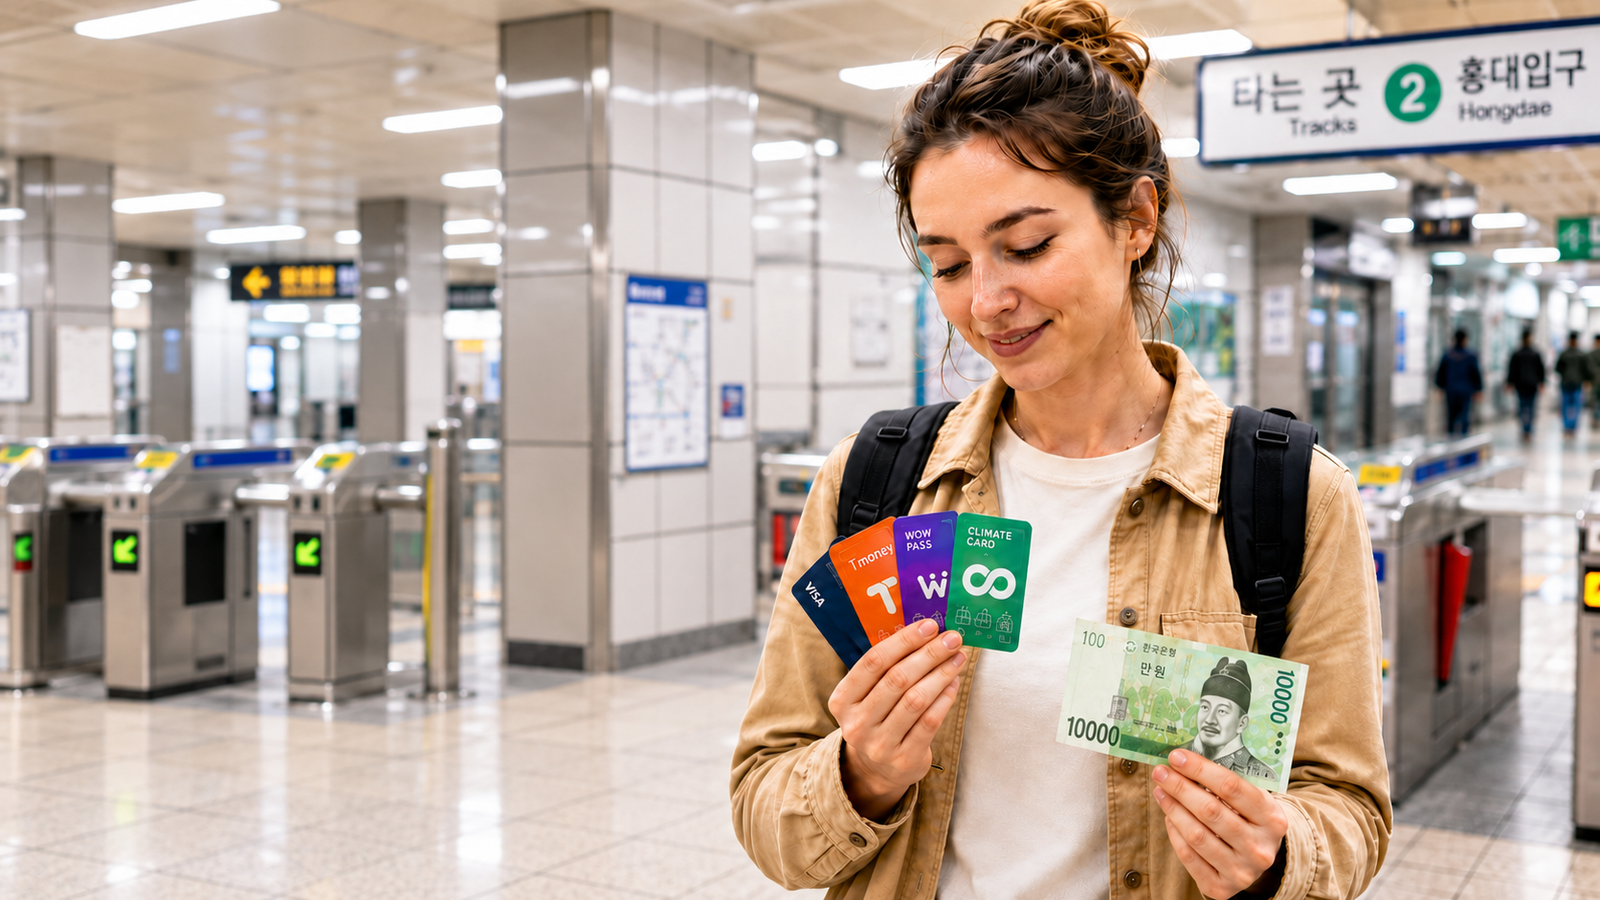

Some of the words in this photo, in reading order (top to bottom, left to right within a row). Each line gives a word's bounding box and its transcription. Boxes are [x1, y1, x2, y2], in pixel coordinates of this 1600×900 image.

[1457, 48, 1587, 95] 홍대입구
[1232, 73, 1304, 113] 타는
[1322, 67, 1361, 109] 곳
[1399, 71, 1427, 113] 2
[1458, 99, 1552, 125] Hongdae
[1289, 116, 1358, 137] Tracks
[904, 528, 932, 541] WOW
[906, 539, 932, 551] PASS
[966, 537, 995, 549] CARD
[967, 526, 1012, 541] CLIMATE
[804, 580, 826, 608] VISA
[1081, 630, 1106, 649] 100
[1270, 669, 1296, 725] 10000
[1067, 716, 1120, 747] 10000
